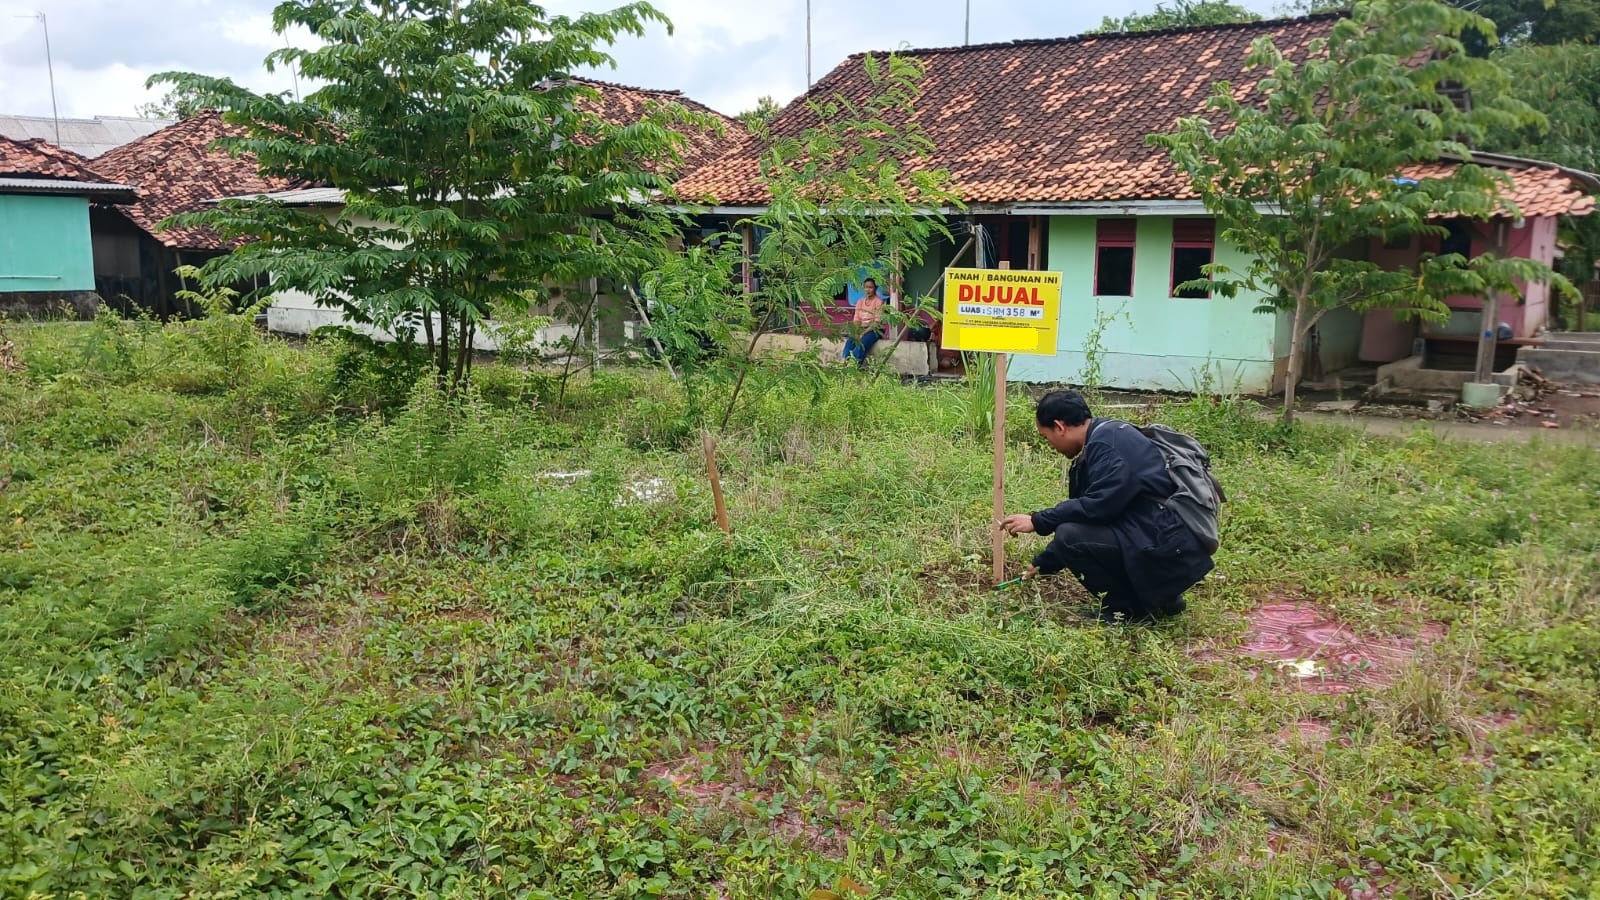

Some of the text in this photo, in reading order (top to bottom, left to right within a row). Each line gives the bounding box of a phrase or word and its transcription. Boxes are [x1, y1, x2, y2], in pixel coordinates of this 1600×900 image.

[948, 272, 979, 281] TANAH
[987, 274, 1041, 283] BANGUNAN
[1044, 276, 1058, 284] INI
[958, 284, 1045, 306] DIJUAL
